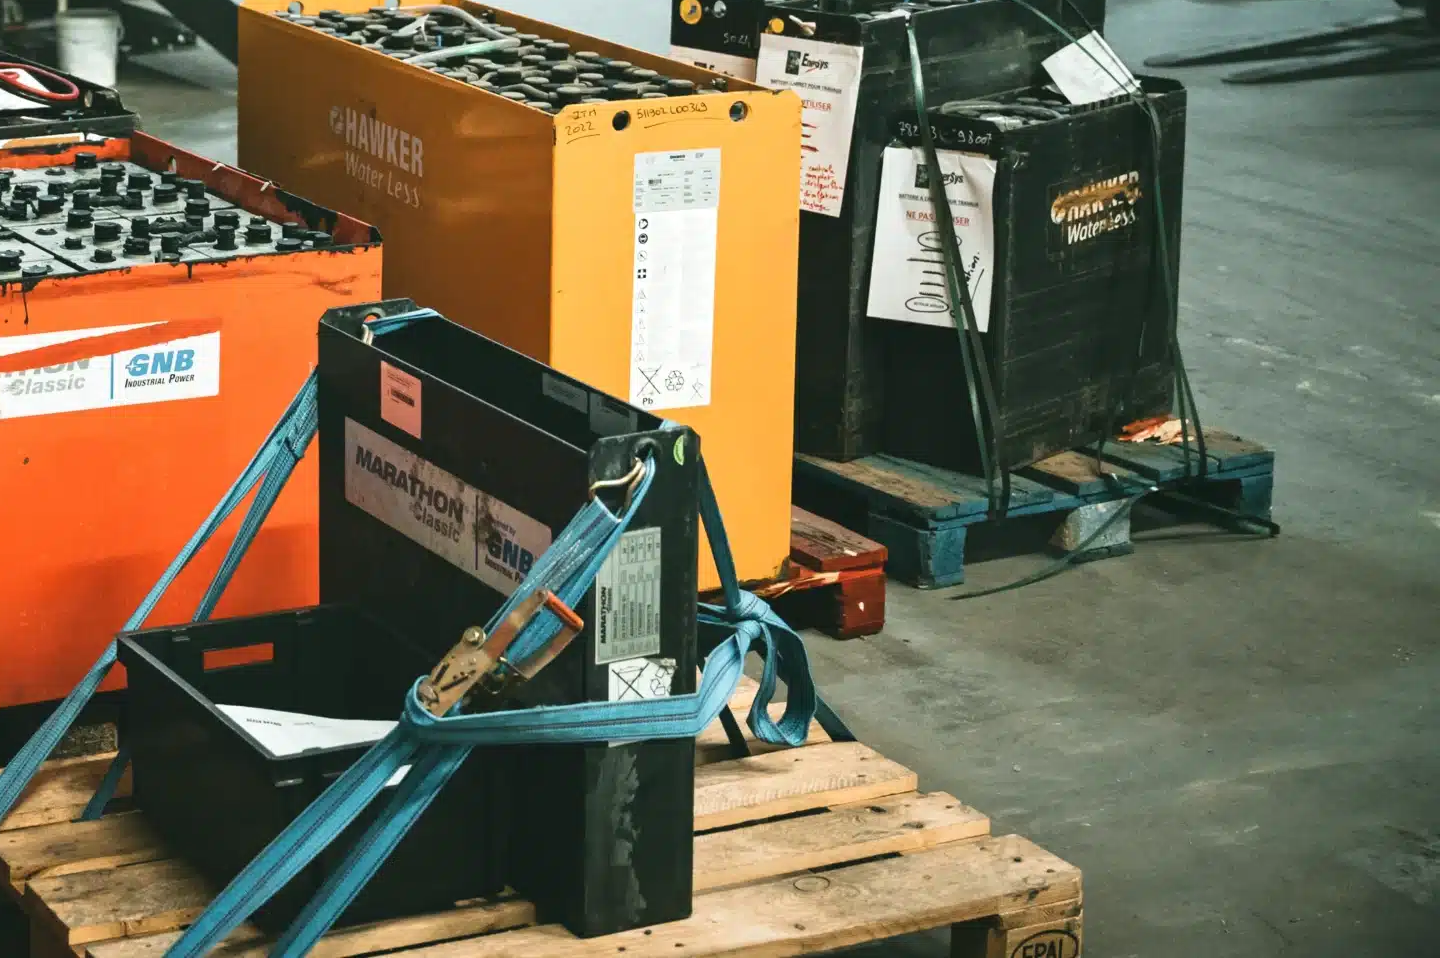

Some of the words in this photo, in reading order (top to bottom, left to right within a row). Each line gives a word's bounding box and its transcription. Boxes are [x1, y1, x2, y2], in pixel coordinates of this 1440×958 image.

[345, 106, 424, 178] HAWKER
[565, 121, 595, 136] 2022
[345, 149, 384, 191] Water
[387, 171, 421, 210] Less
[906, 209, 917, 219] NE
[125, 349, 195, 377] GNB
[9, 374, 86, 397] Classic
[642, 397, 654, 406] Pb
[355, 445, 465, 523] MARATHON
[412, 501, 461, 543] Classic
[487, 531, 534, 577] GNB
